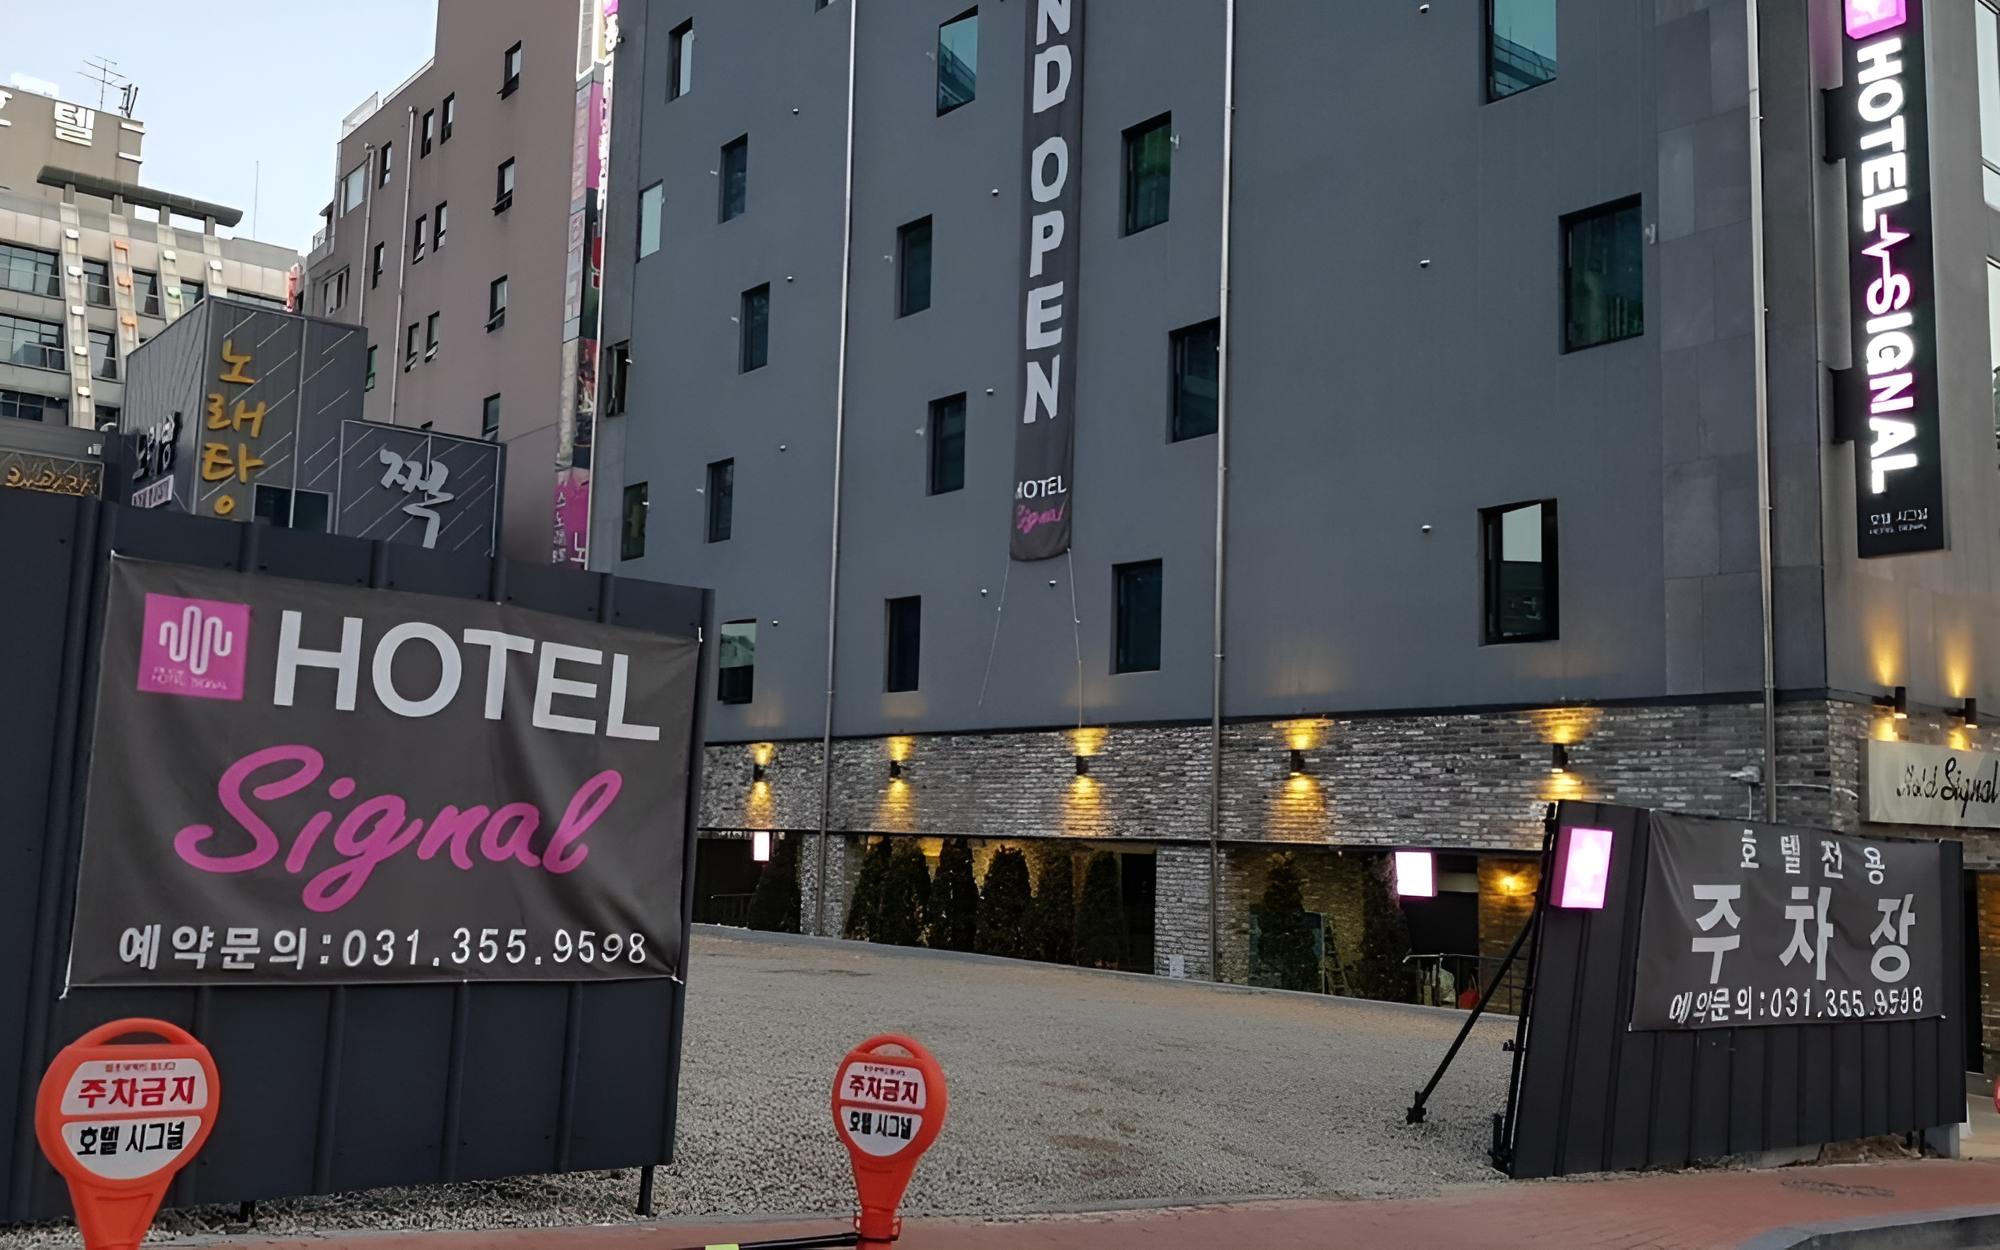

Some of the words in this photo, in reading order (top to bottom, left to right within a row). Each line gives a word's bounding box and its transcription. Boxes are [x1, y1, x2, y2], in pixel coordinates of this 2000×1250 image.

[1856, 36, 1908, 233] HOTEL
[1023, 136, 1070, 425] OPEN
[1865, 270, 1920, 496] SIGNAL
[273, 609, 660, 742] HOTEL
[173, 744, 622, 913] Signal
[1691, 884, 1916, 985] 주차장
[77, 1126, 119, 1156] 호텔
[125, 1120, 186, 1153] 시그널
[78, 1076, 196, 1108] 주차금지
[849, 1074, 918, 1105] 주차금지
